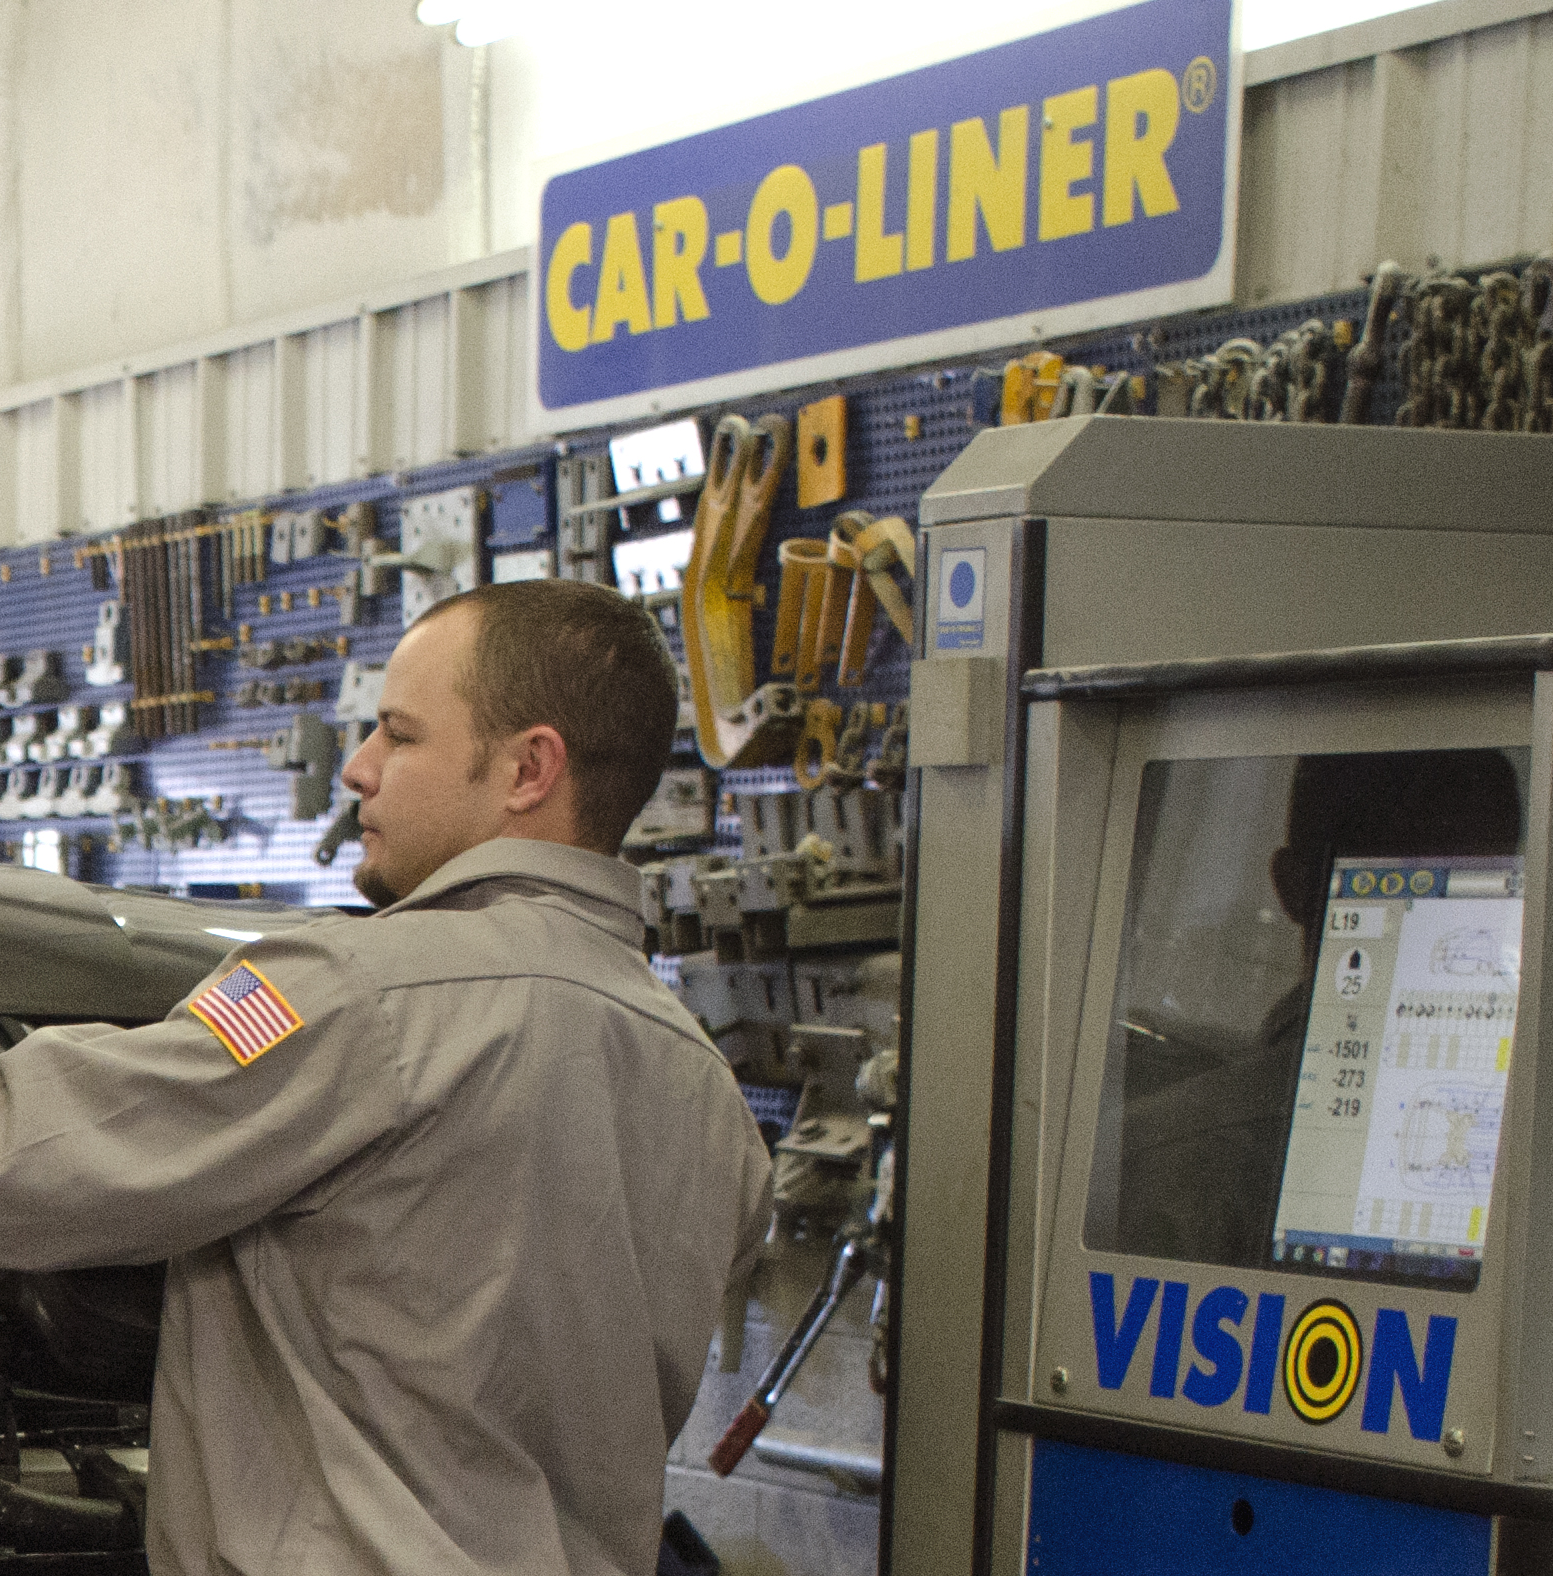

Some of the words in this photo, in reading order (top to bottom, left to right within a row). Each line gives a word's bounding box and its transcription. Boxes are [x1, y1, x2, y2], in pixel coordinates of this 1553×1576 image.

[1330, 911, 1360, 931] L19
[1341, 974, 1362, 995] 25
[1088, 1269, 1458, 1443] VISION
